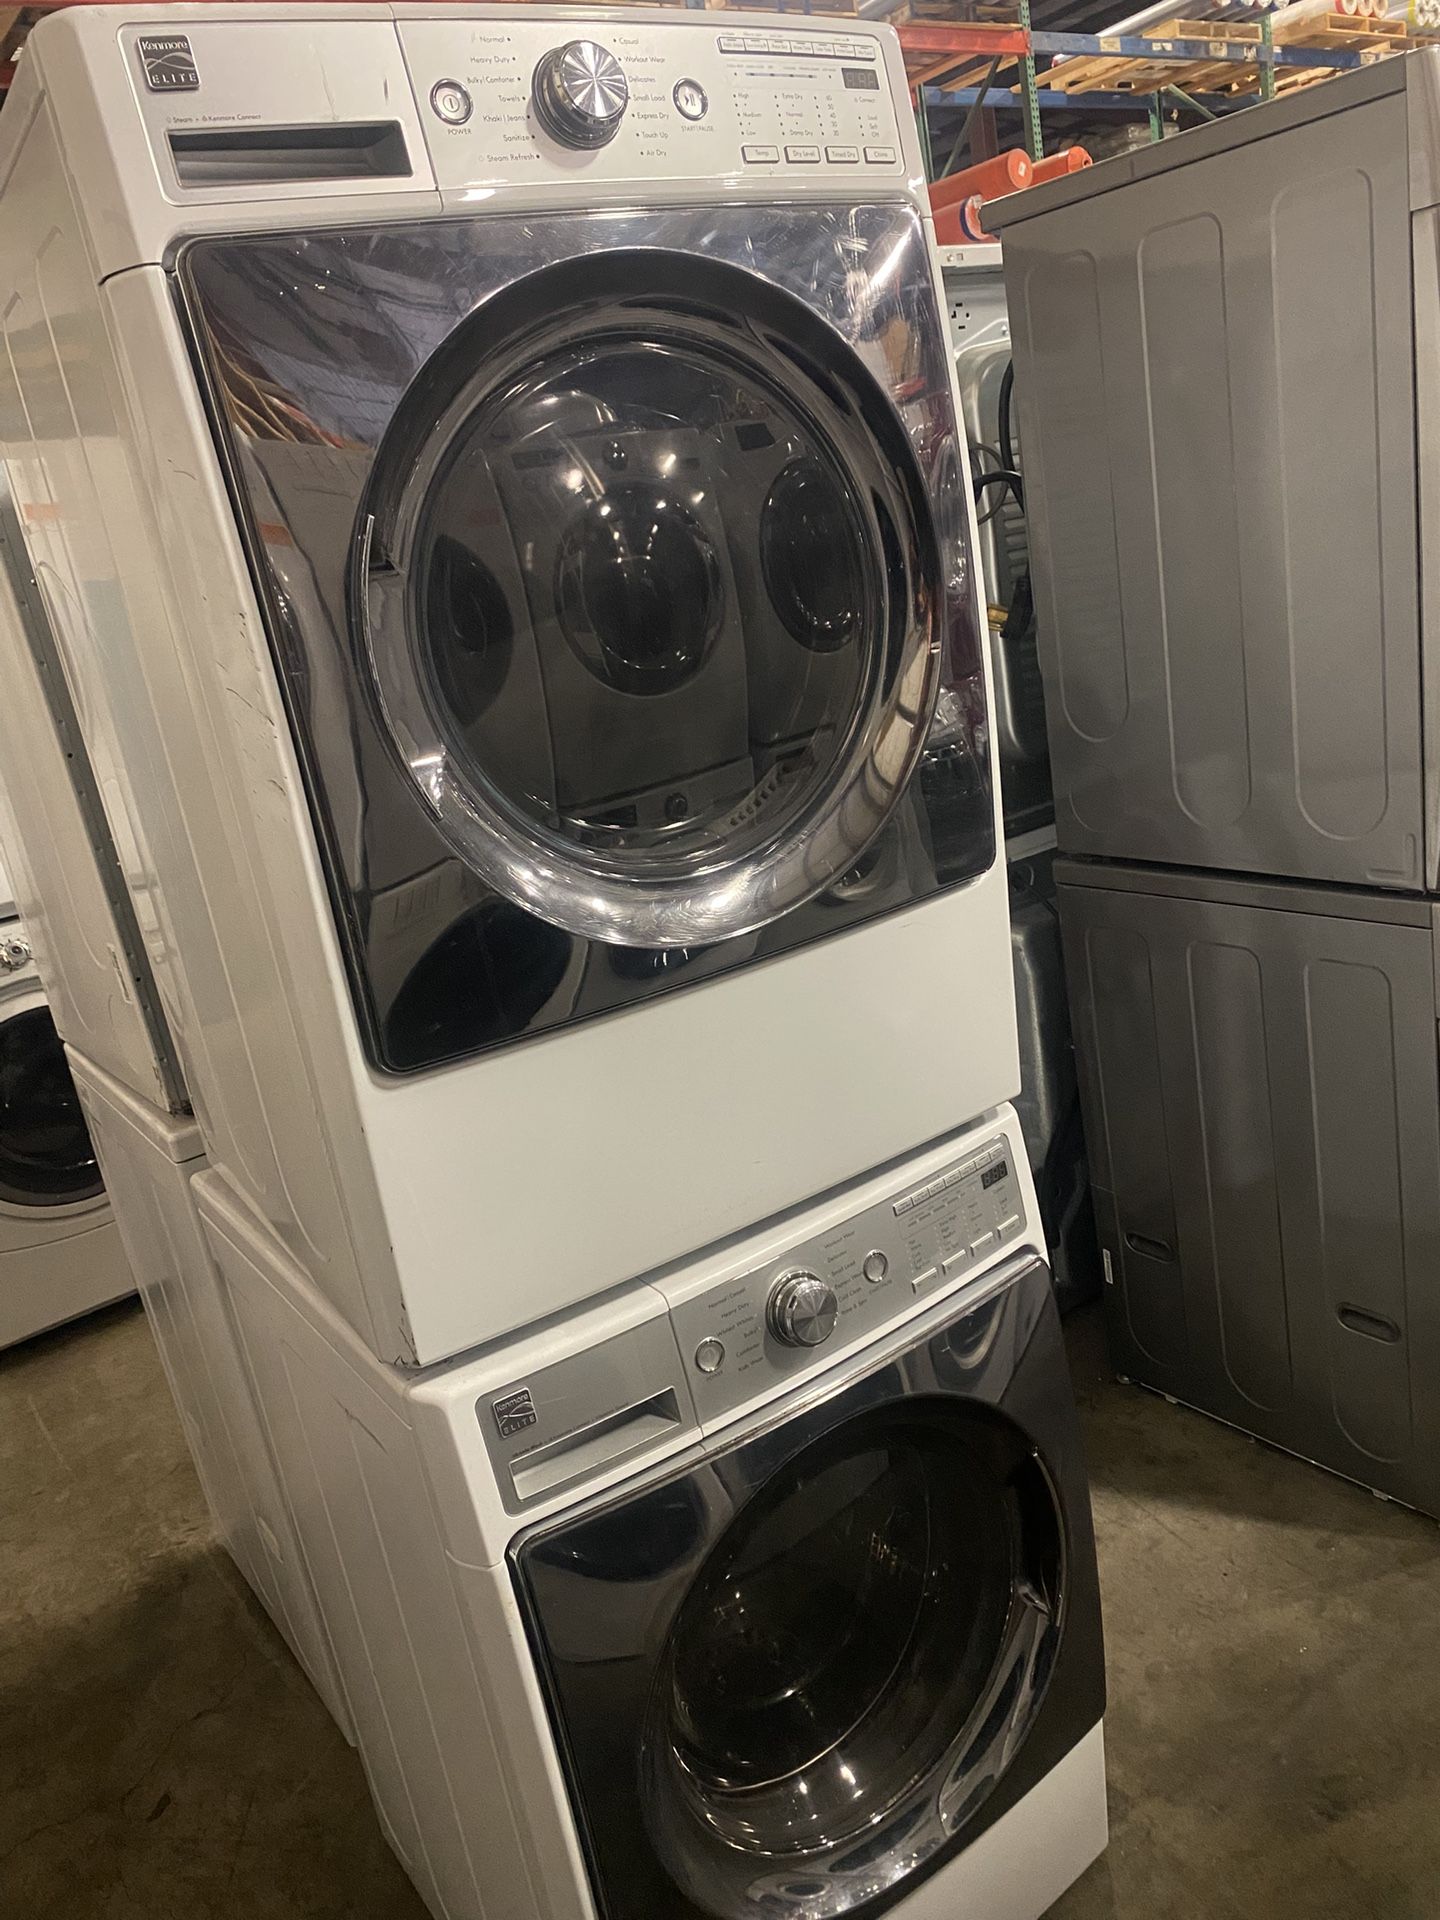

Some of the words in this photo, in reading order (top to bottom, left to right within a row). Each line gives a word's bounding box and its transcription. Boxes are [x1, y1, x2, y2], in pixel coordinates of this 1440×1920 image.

[618, 37, 640, 45] Casual
[141, 40, 189, 51] Kenmore
[151, 72, 198, 84] ELITE
[632, 94, 651, 102] Small
[236, 113, 261, 121] Connect
[636, 112, 658, 120] Express
[503, 134, 530, 142] Sanitize
[660, 131, 668, 139] Up
[487, 154, 509, 162] Steam
[510, 152, 535, 161] Refresh
[656, 149, 667, 157] Dry
[792, 149, 802, 157] Dry
[496, 1392, 529, 1411] Kenmore
[503, 1414, 536, 1434] ELITE
